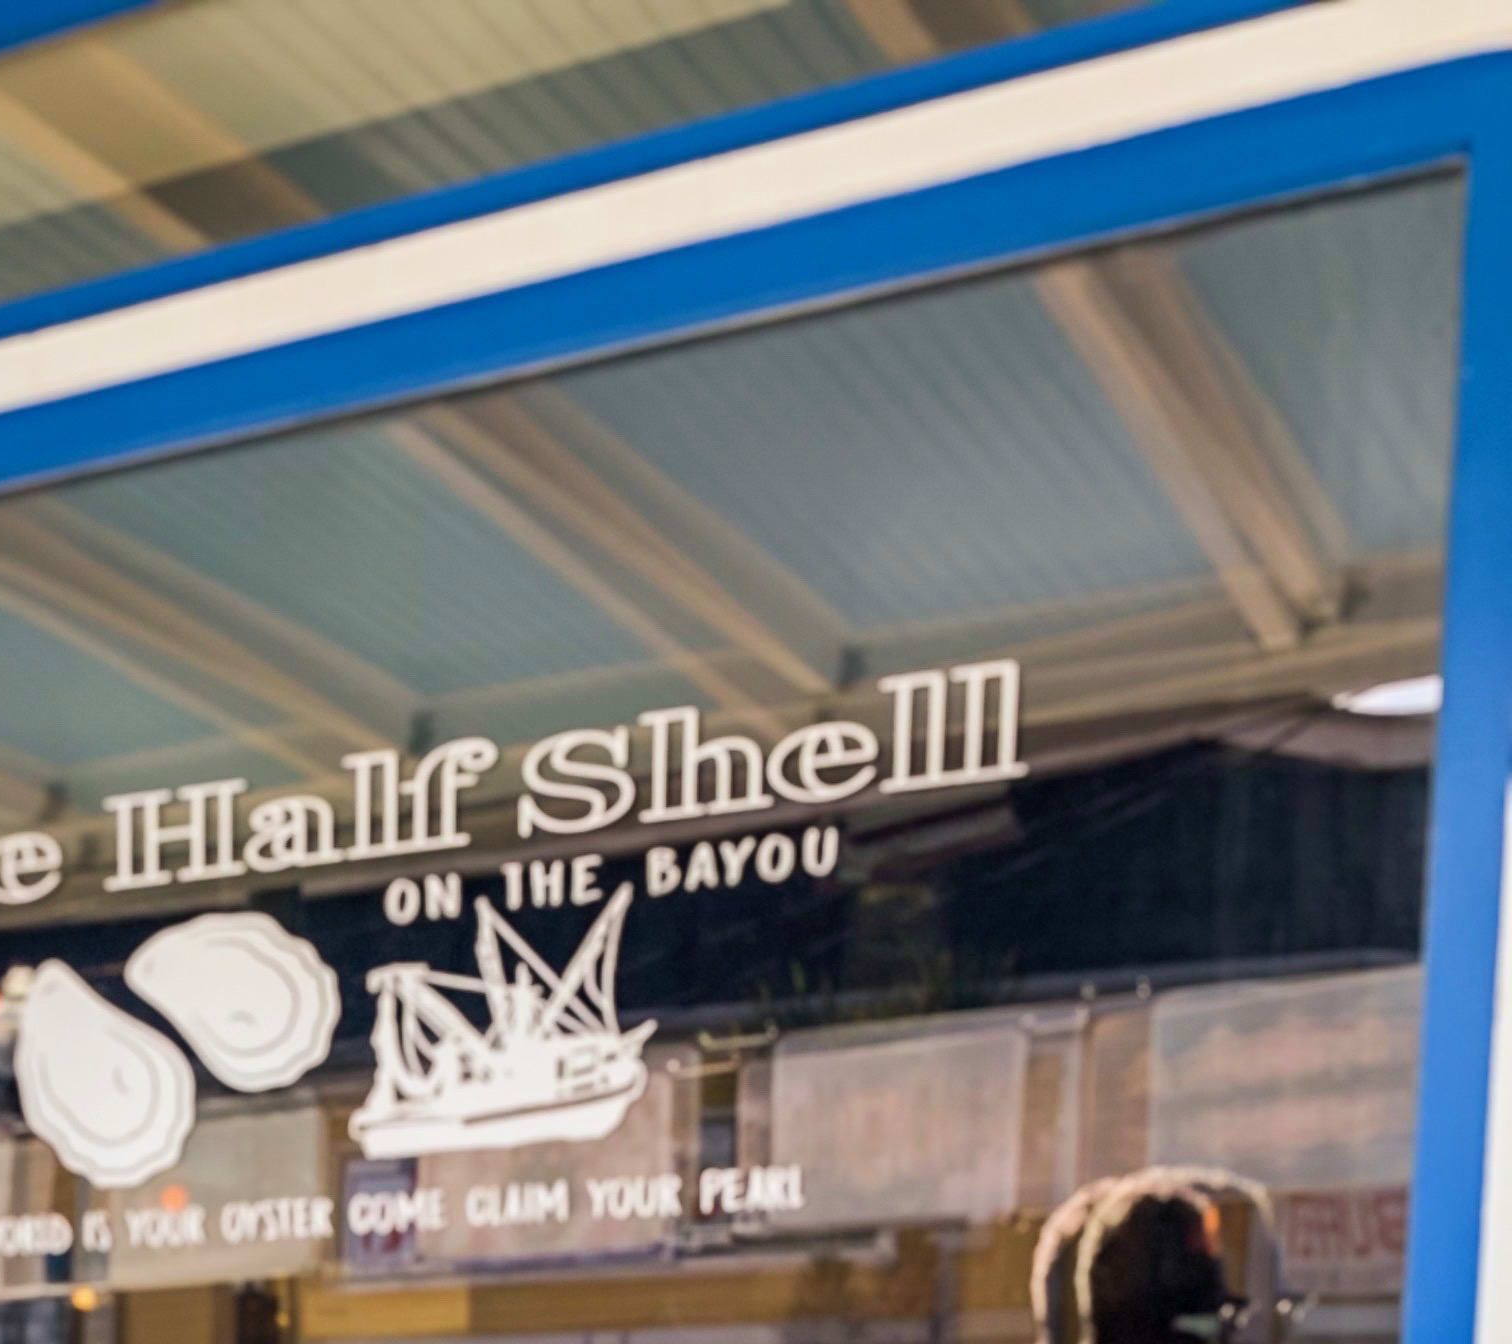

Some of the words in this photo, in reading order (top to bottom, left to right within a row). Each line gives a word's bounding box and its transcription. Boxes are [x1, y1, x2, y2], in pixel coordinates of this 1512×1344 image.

[102, 736, 499, 892] Half
[517, 659, 1030, 838] Shell
[384, 871, 463, 926] ON
[501, 854, 604, 911] THE
[646, 826, 840, 897] BAYOU
[82, 1209, 113, 1253] IS
[125, 1203, 205, 1249] YOUR
[220, 1195, 335, 1241] OYSTER
[347, 1187, 448, 1236] COME
[465, 1178, 569, 1226] CLAIM
[586, 1172, 684, 1220] YOUR
[697, 1163, 806, 1215] PEARL
